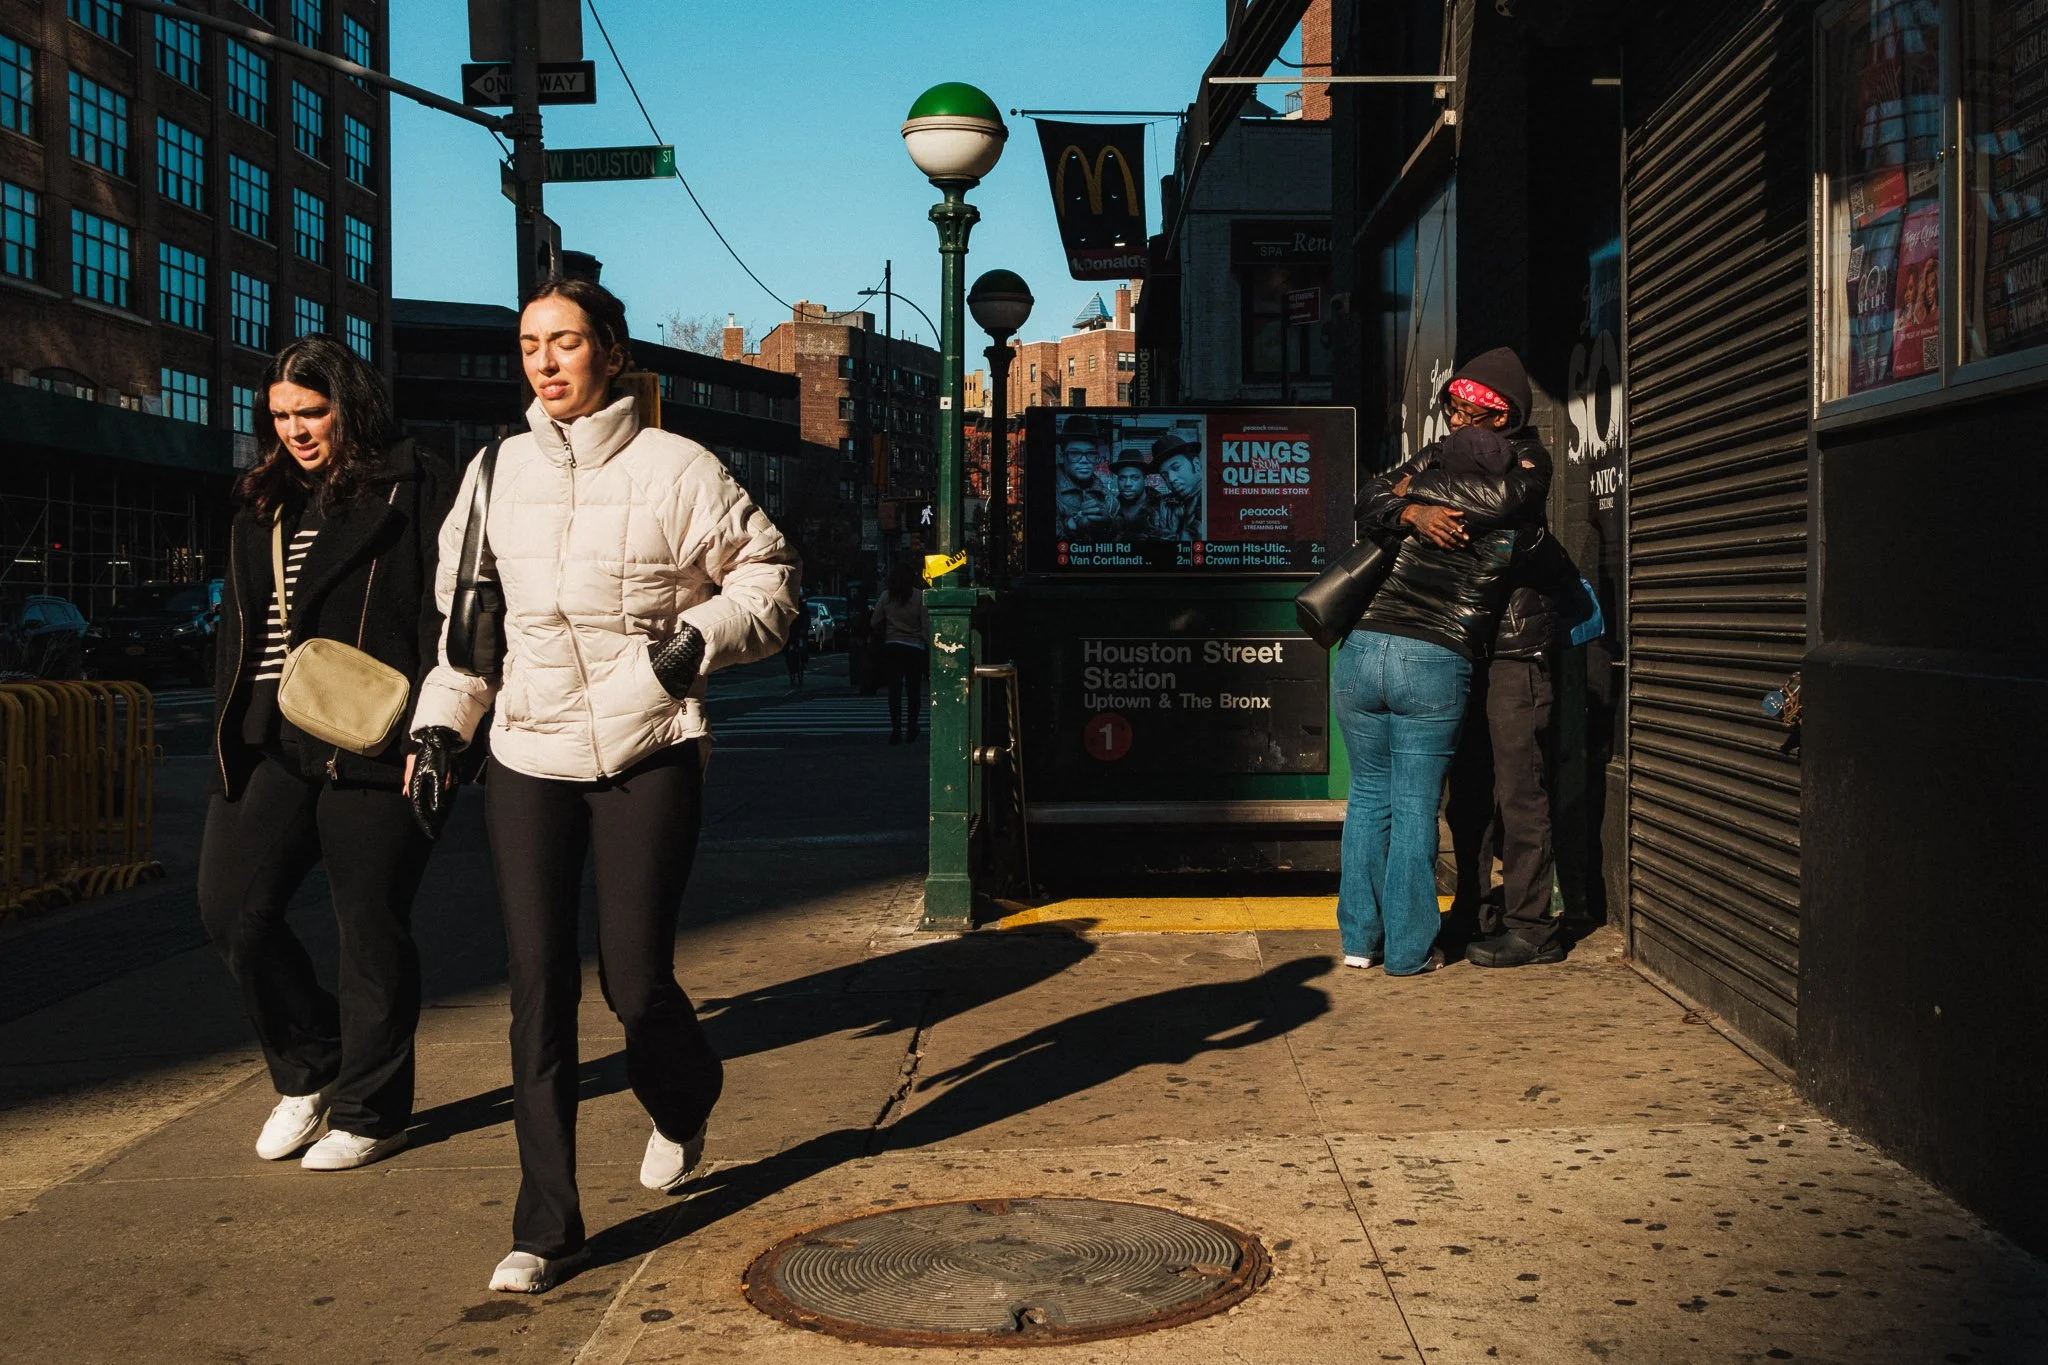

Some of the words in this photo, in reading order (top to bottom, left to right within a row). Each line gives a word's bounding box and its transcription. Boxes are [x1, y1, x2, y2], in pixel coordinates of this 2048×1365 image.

[484, 76, 512, 94] ON
[538, 75, 577, 92] WAY
[549, 155, 564, 178] W
[571, 151, 656, 178] HOUSTON
[662, 150, 673, 163] ST
[1260, 246, 1284, 257] SPA
[1222, 441, 1311, 464] KINGS
[1251, 457, 1280, 472] FROM
[1222, 466, 1311, 487] QUEENS
[1595, 466, 1617, 496] NYC
[1239, 505, 1289, 521] peacock
[1069, 543, 1093, 553] Gun
[1095, 543, 1113, 553] Hill
[1116, 543, 1131, 553] Rd
[1176, 543, 1191, 553] 1m
[1205, 543, 1240, 553] Crown
[1242, 543, 1292, 553] Hts-Utic..
[1311, 543, 1326, 553] 2m
[1069, 555, 1090, 565] Van
[1093, 555, 1143, 565] Cortlandt
[1176, 555, 1191, 565] 2m
[1205, 555, 1240, 565] Crown
[1242, 555, 1292, 565] Hts-Utic..
[1311, 555, 1326, 565] 4m
[1083, 641, 1192, 664] Houston
[1203, 641, 1284, 664] Street
[1082, 667, 1176, 690] Station
[1083, 693, 1151, 713] Uptown
[1158, 693, 1172, 710] &
[1179, 693, 1213, 710] The
[1219, 693, 1272, 710] Bronx
[1098, 723, 1112, 751] 1
